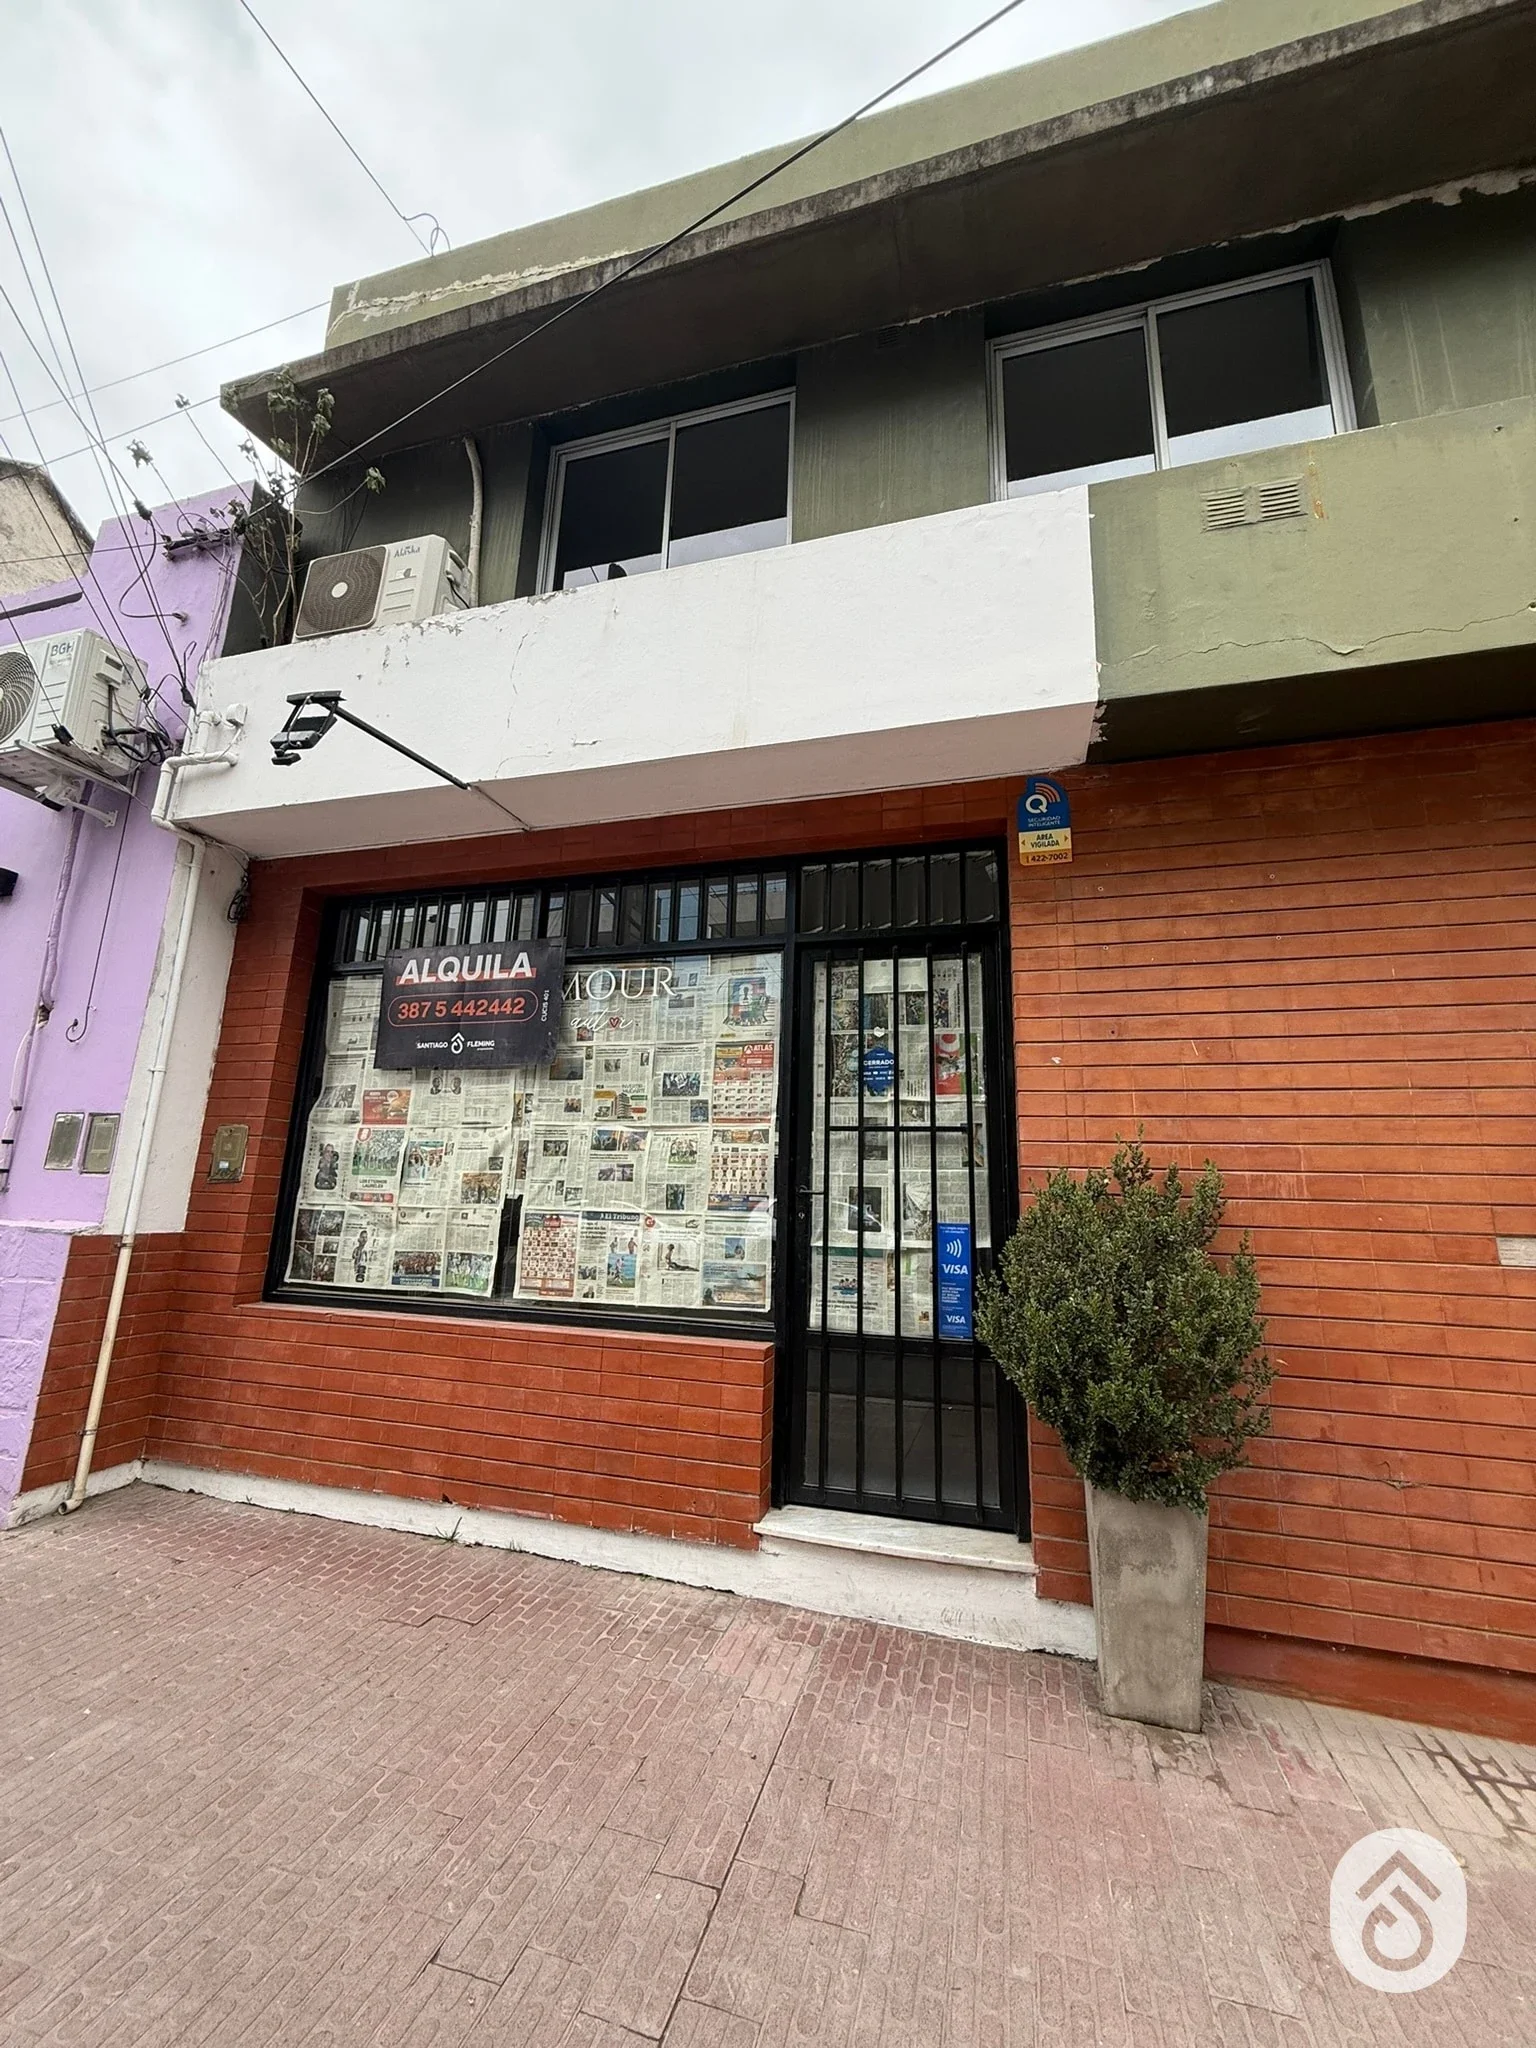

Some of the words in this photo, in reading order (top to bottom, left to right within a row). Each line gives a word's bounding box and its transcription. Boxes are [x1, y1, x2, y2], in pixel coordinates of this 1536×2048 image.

[1030, 839, 1060, 849] VIGILADA
[1030, 852, 1069, 862] 422-7002
[398, 951, 533, 984] ALQUILA
[397, 1000, 432, 1020] 387
[434, 1000, 448, 1018] 5
[450, 997, 526, 1017] 442442
[416, 1041, 449, 1049] SANTIAGO
[466, 1040, 496, 1048] FLEMING
[941, 1263, 969, 1275] VISA
[945, 1314, 966, 1324] VISA
